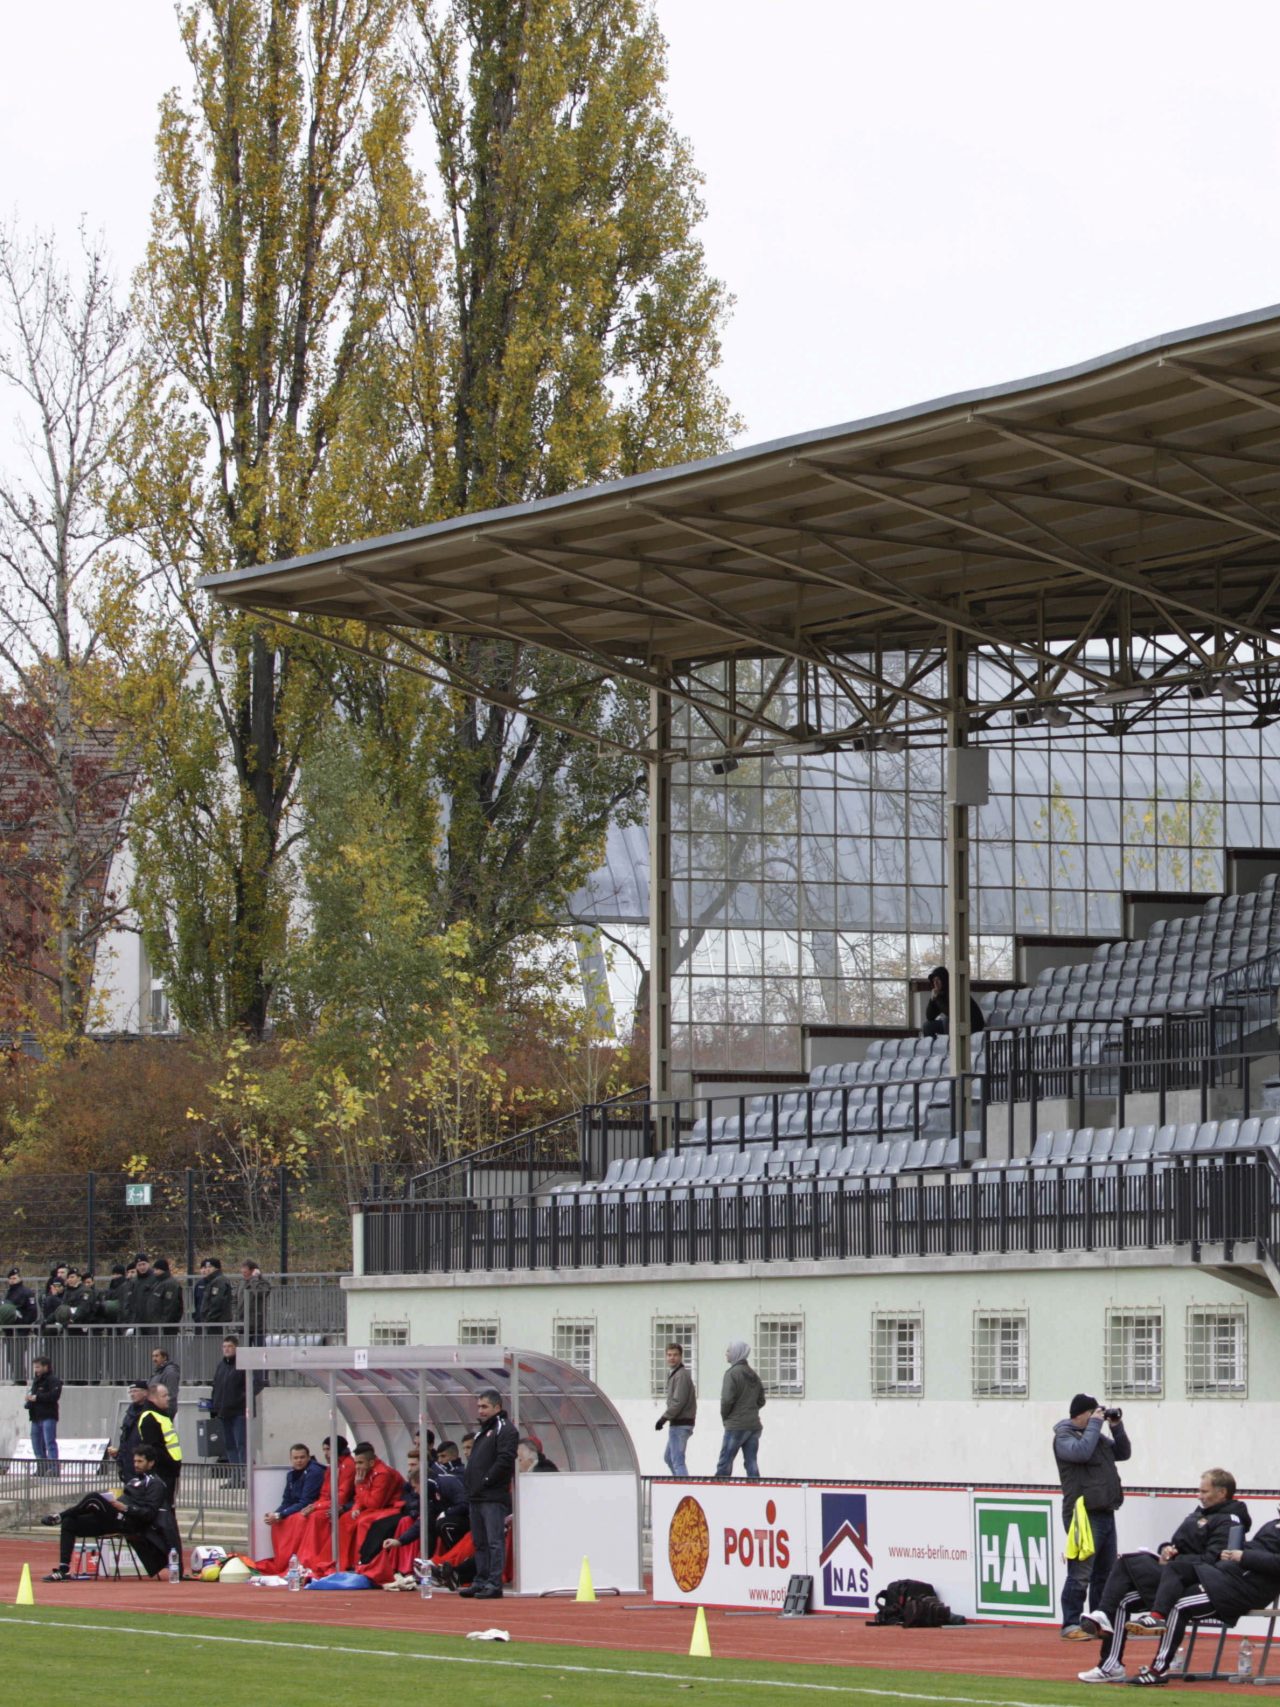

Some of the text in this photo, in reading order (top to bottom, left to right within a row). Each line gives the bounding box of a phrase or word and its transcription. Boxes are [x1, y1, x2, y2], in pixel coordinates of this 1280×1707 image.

[724, 1500, 790, 1569] POTIS
[888, 1543, 968, 1561] www.nas-berlin.com
[981, 1522, 1048, 1593] HAN
[833, 1567, 869, 1593] NAS
